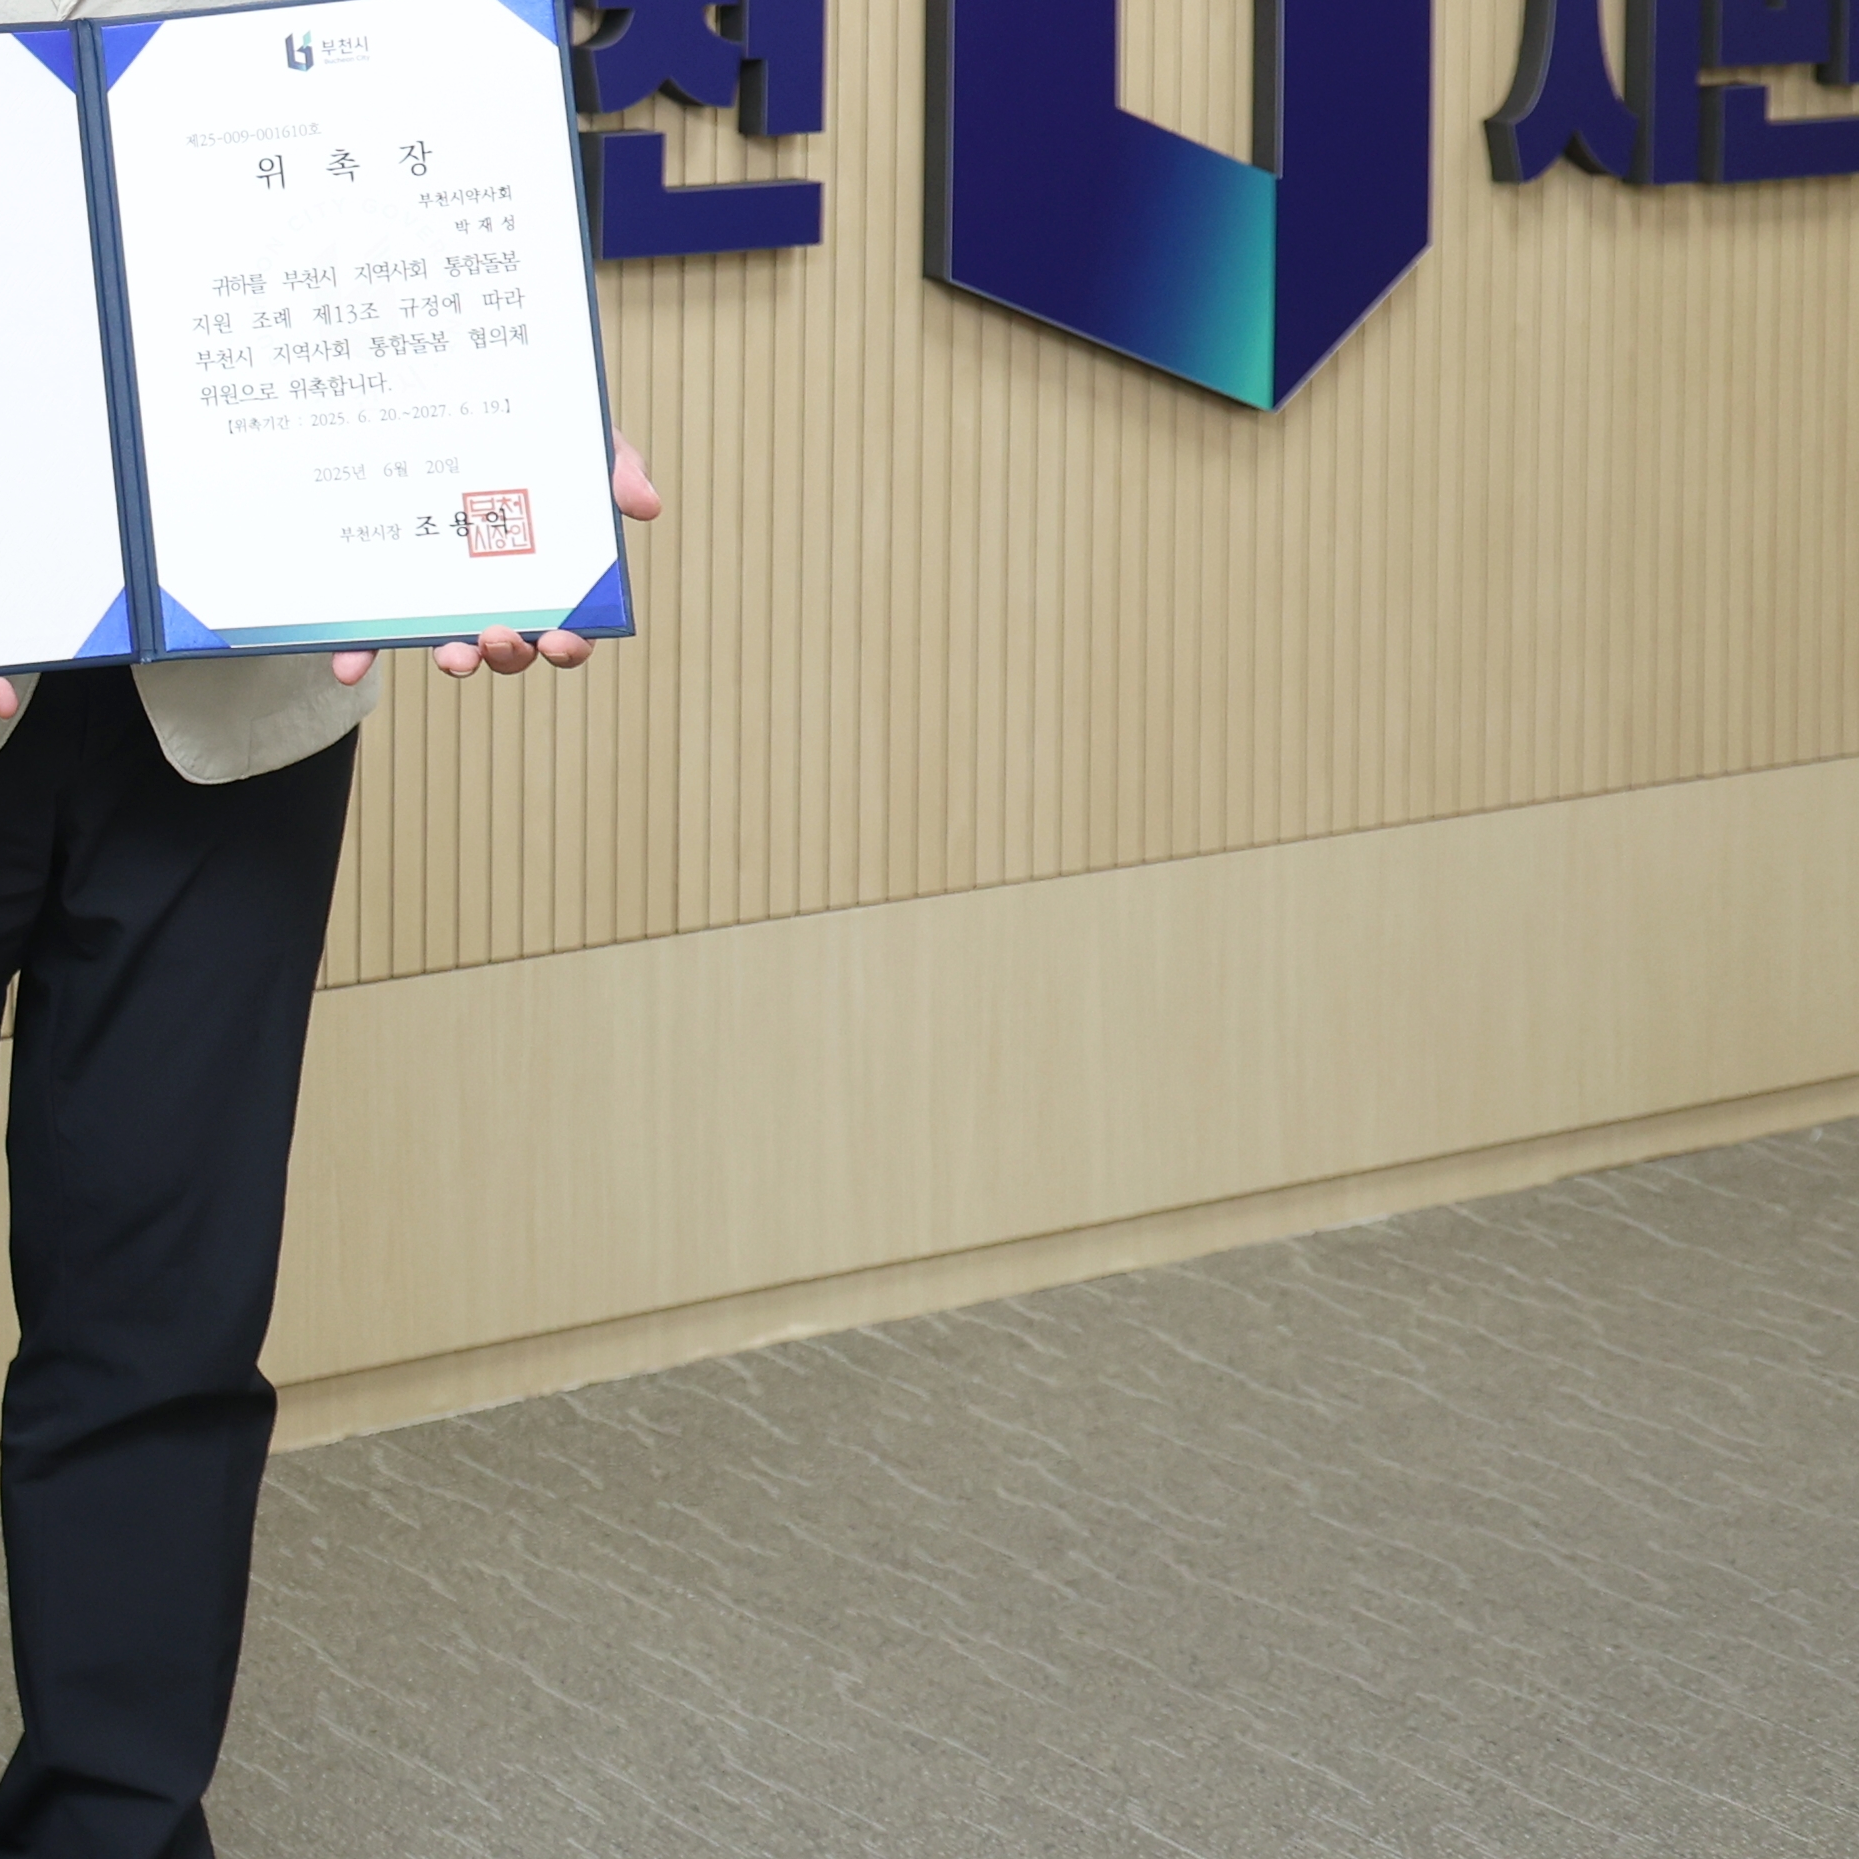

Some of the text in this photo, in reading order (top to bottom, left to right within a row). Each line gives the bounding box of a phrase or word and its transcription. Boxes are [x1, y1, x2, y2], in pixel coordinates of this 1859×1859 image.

[321, 35, 369, 56] 부천시
[323, 54, 371, 66] Bucheon City
[186, 122, 322, 148] 제25-009-001610호
[418, 184, 512, 209] 부천시약사회
[211, 250, 521, 298] 귀하를 부천시 지역사회 통합돌봄
[192, 286, 526, 336] 지원 조례 제13조 규정에 따라
[195, 323, 529, 372] 부천시 지역사회 통합돌봄 협의체
[199, 382, 279, 407] 위원으로
[288, 371, 392, 400] 위촉합니다.
[310, 411, 350, 427] 2025.
[313, 456, 461, 483] 2025년 6월 20일
[339, 522, 403, 544] 부천시장
